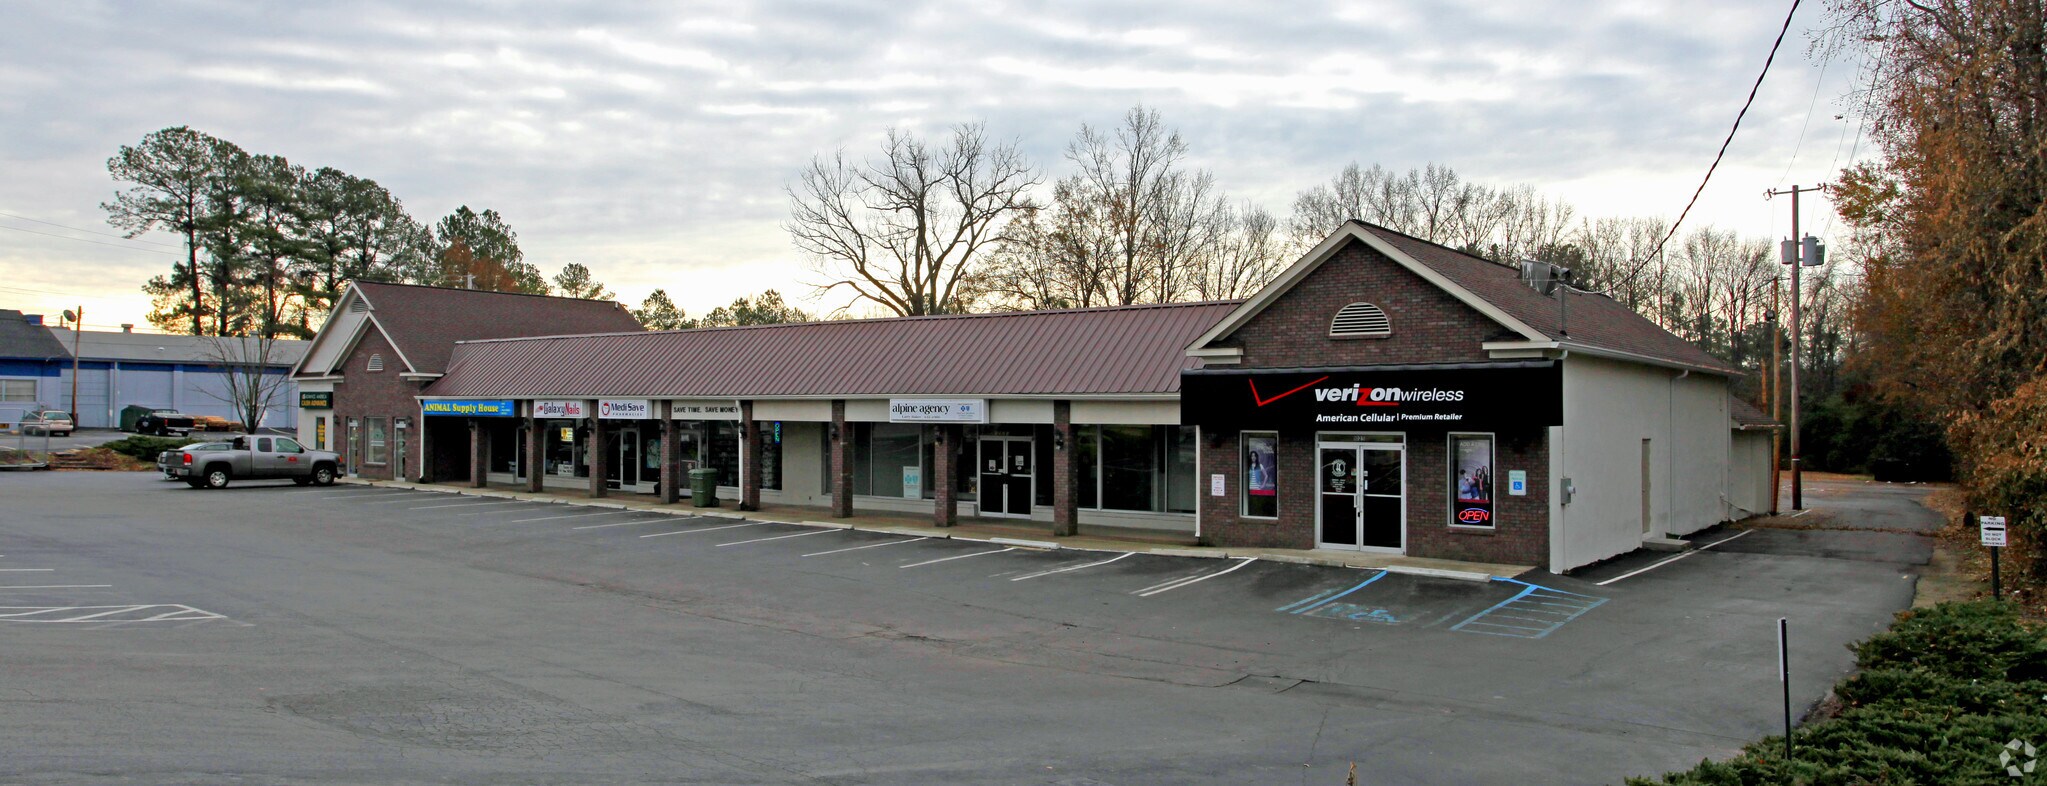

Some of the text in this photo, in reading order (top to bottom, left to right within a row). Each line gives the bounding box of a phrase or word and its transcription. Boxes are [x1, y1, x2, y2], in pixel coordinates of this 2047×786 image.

[424, 403, 451, 412] ANIMAL
[452, 403, 477, 414] Supply
[478, 403, 499, 413] House
[892, 403, 950, 415] alpine agency
[1316, 413, 1358, 422] American
[1360, 413, 1396, 422] Cellular
[1434, 413, 1462, 421] Retailer
[1458, 510, 1490, 521] OPEN
